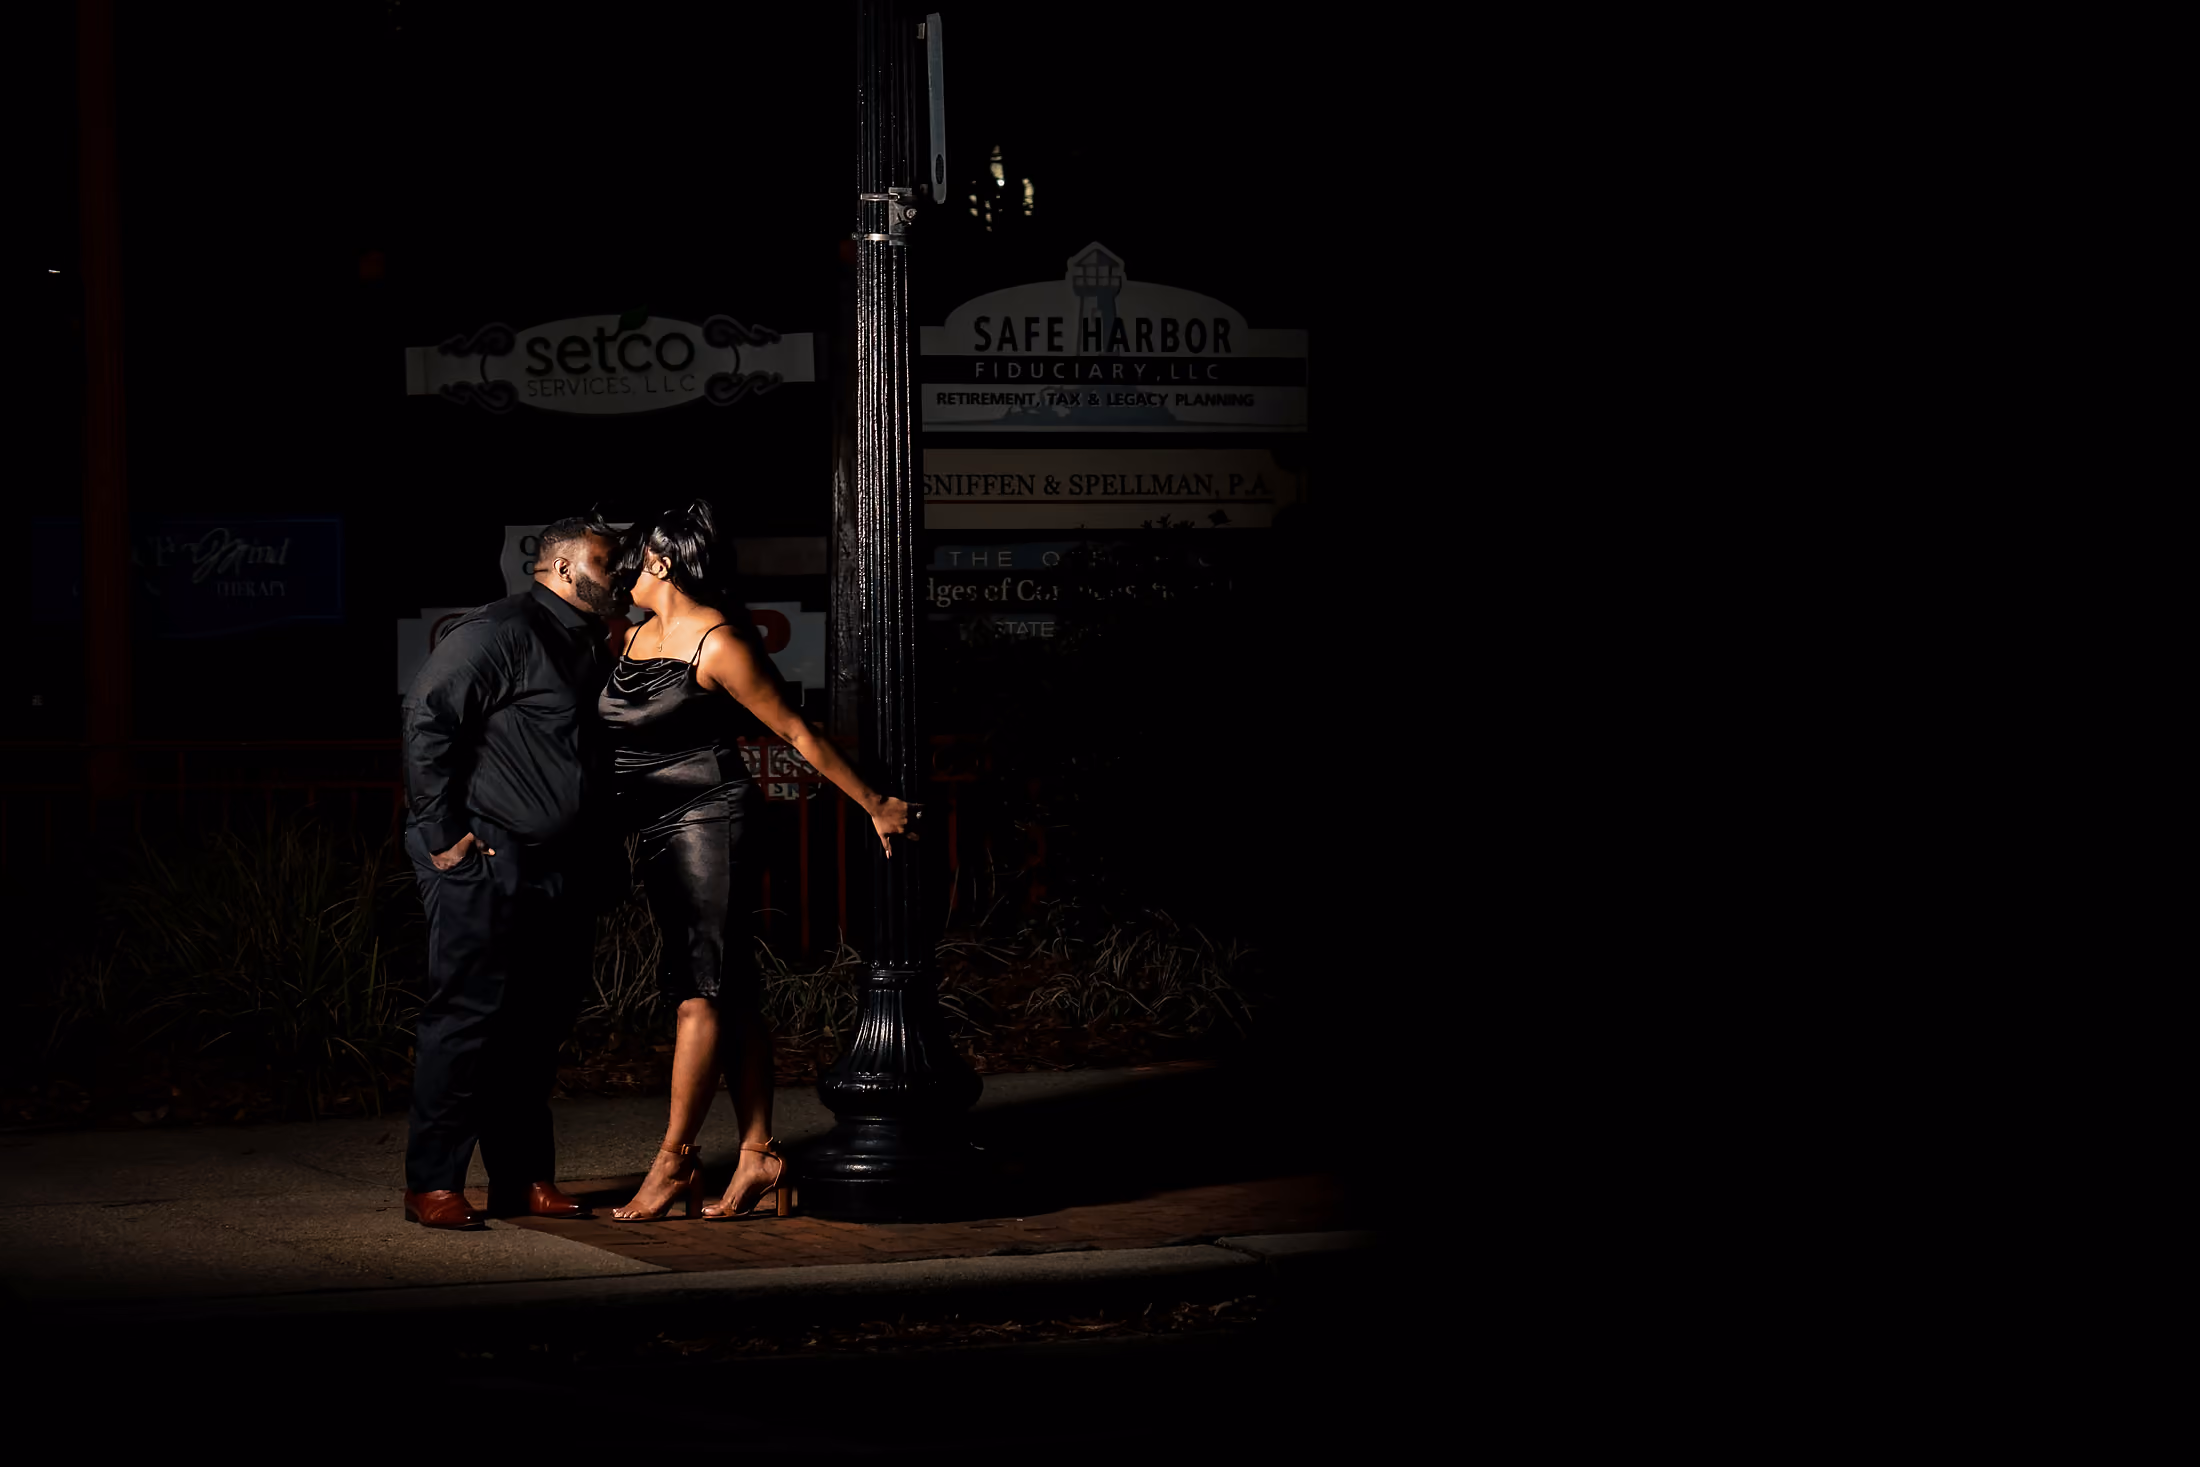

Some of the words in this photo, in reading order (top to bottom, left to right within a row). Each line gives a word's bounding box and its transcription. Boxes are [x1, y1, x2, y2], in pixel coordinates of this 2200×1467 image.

[974, 316, 1064, 352] SAFE
[1082, 317, 1231, 353] HARBOR
[526, 327, 695, 376] setco
[936, 392, 1041, 408] RETIREMENT,
[1047, 393, 1080, 406] TAX
[1088, 393, 1100, 406] &
[1107, 392, 1168, 407] LEGACY
[1175, 392, 1254, 407] PLANNING
[923, 474, 1035, 496] SNIFFEN
[1043, 474, 1060, 496] &
[1069, 473, 1220, 498] SPELLMAN,
[949, 551, 1013, 568] THE
